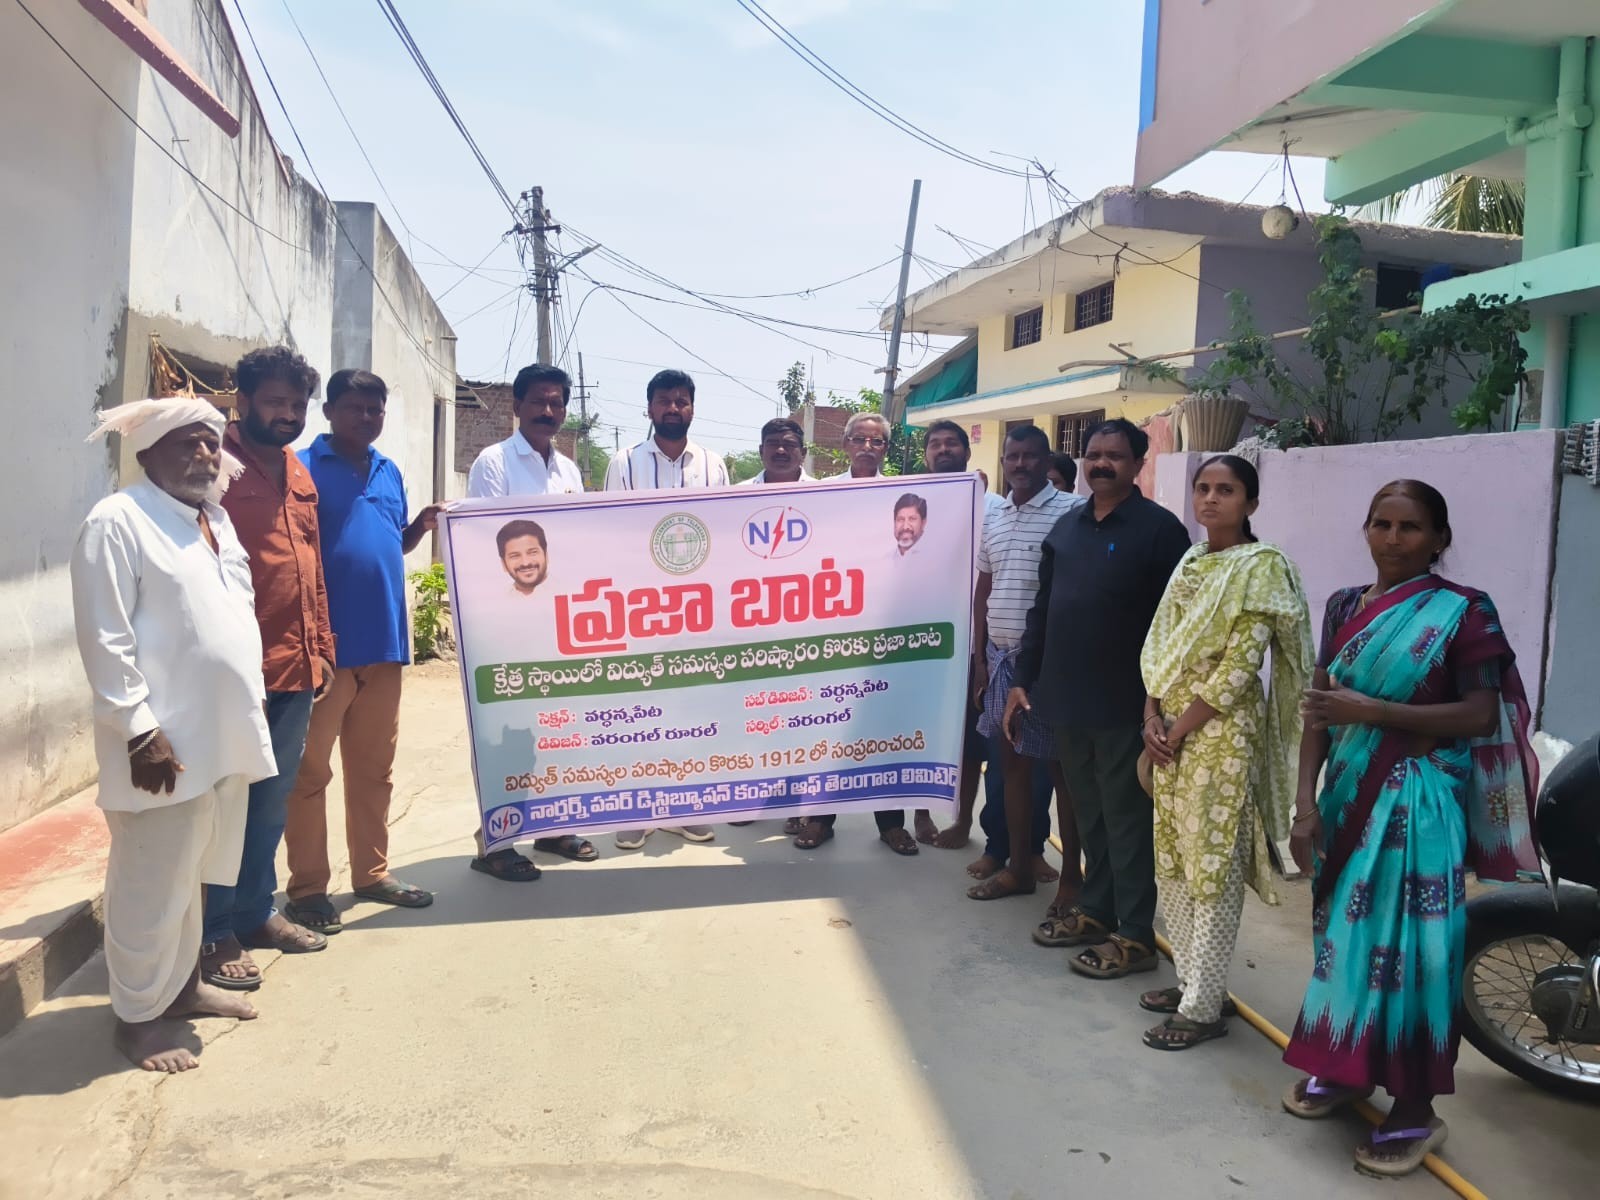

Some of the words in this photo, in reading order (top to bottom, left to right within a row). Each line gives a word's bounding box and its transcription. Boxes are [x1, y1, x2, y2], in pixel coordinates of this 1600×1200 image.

[554, 578, 713, 656] ప్రజా
[730, 558, 864, 628] బాట
[492, 663, 524, 697] క్షేత్ర
[528, 658, 602, 696] స్థాయిలో
[607, 654, 665, 687] విద్యుత్
[668, 651, 737, 680] సమస్యల
[740, 643, 819, 670] పరిష్కారం
[823, 635, 870, 659] కొరకు
[873, 633, 906, 659] ప్రజా
[908, 626, 942, 648] బాట
[591, 727, 662, 746] వరంగల్
[665, 722, 719, 741] రూరల్
[788, 707, 852, 728] వరంగల్
[505, 766, 558, 793] విద్యుత్
[562, 765, 627, 787] సమస్యల
[632, 758, 706, 782] పరిష్కారం
[709, 753, 754, 772] కొరకు
[759, 749, 806, 767] 1912
[809, 740, 828, 762] లో
[831, 730, 925, 762] సంప్రదించండి
[591, 791, 632, 812] పవర్
[734, 780, 787, 801] కంపెనీ
[790, 775, 821, 797] ఆఫ్
[825, 769, 898, 792] తెలంగాణ
